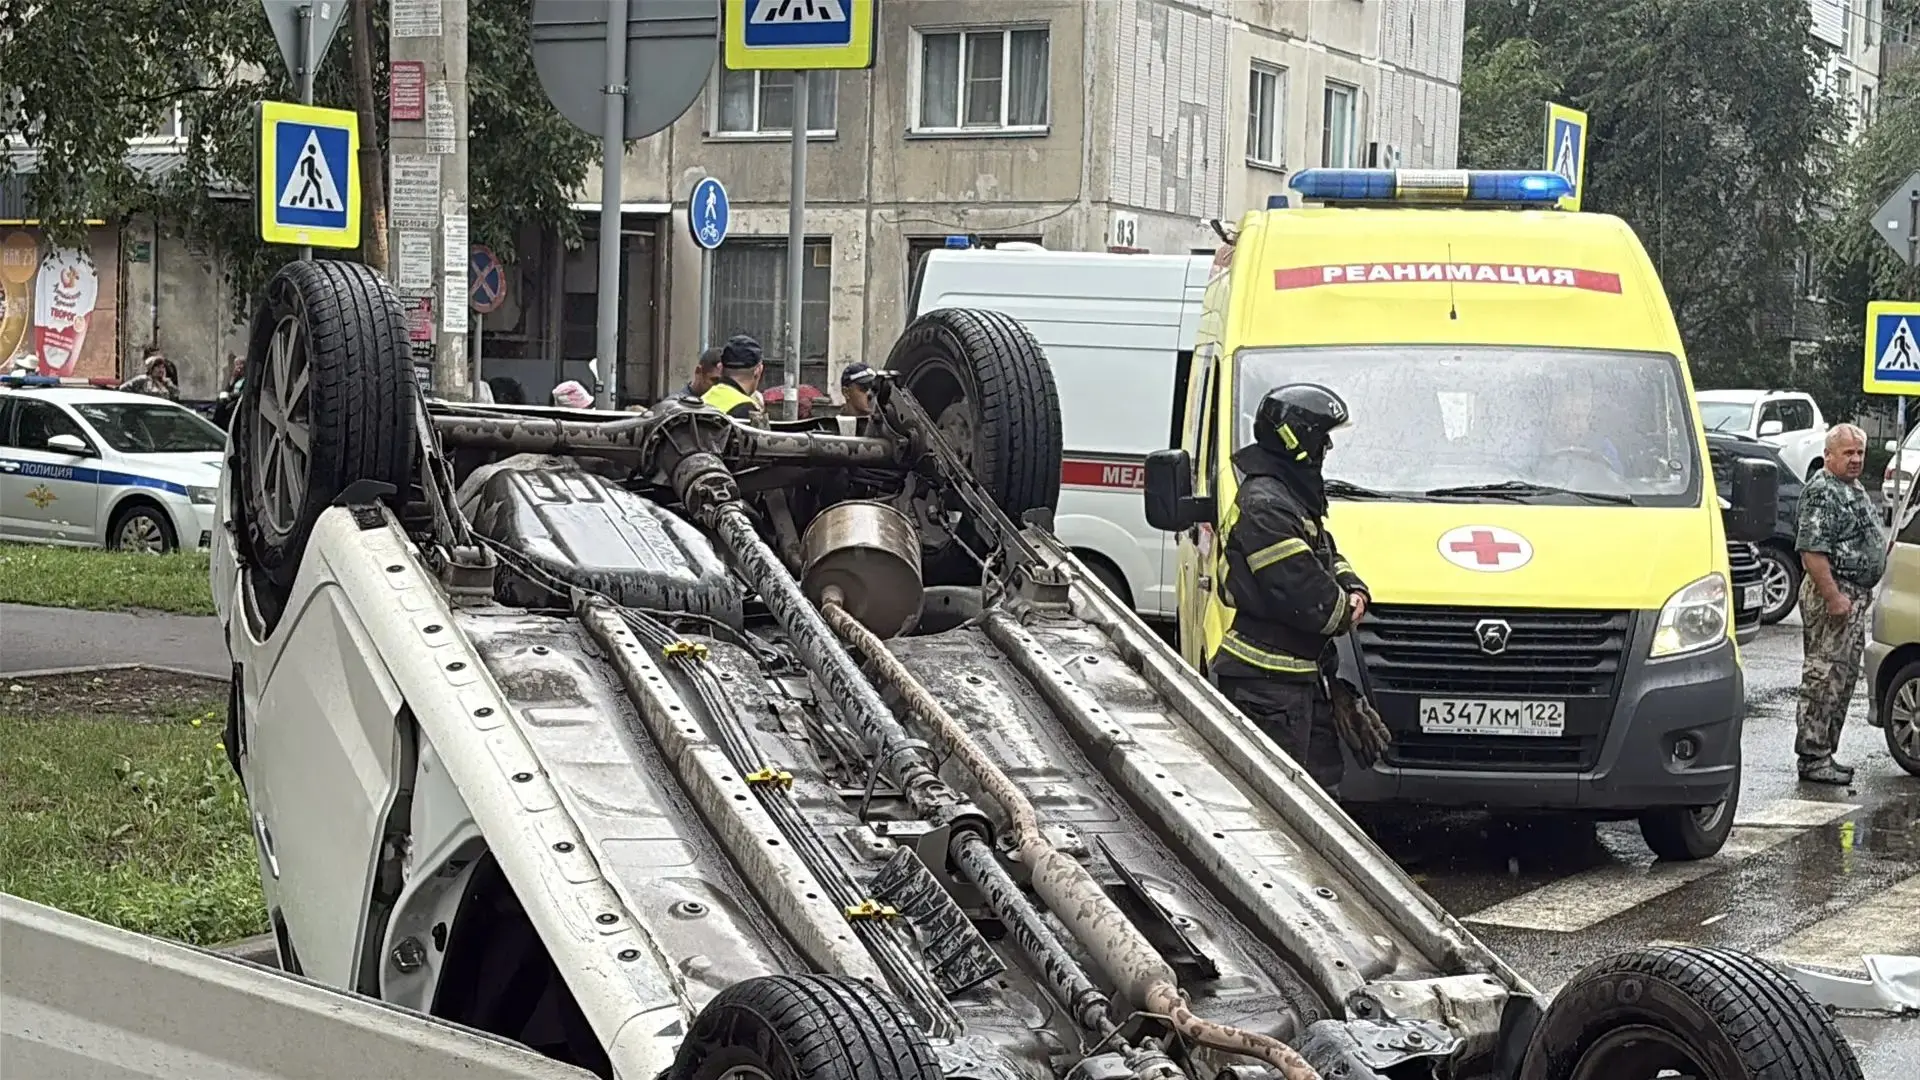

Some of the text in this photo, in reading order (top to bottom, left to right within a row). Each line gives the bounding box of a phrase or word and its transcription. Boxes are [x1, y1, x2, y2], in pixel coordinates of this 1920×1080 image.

[1116, 218, 1135, 247] 83
[1322, 264, 1576, 286] РЕАНИМАЦИЯ
[21, 462, 73, 478] ПОЛИЦИЯ
[1426, 702, 1559, 727] А347КМ 122
